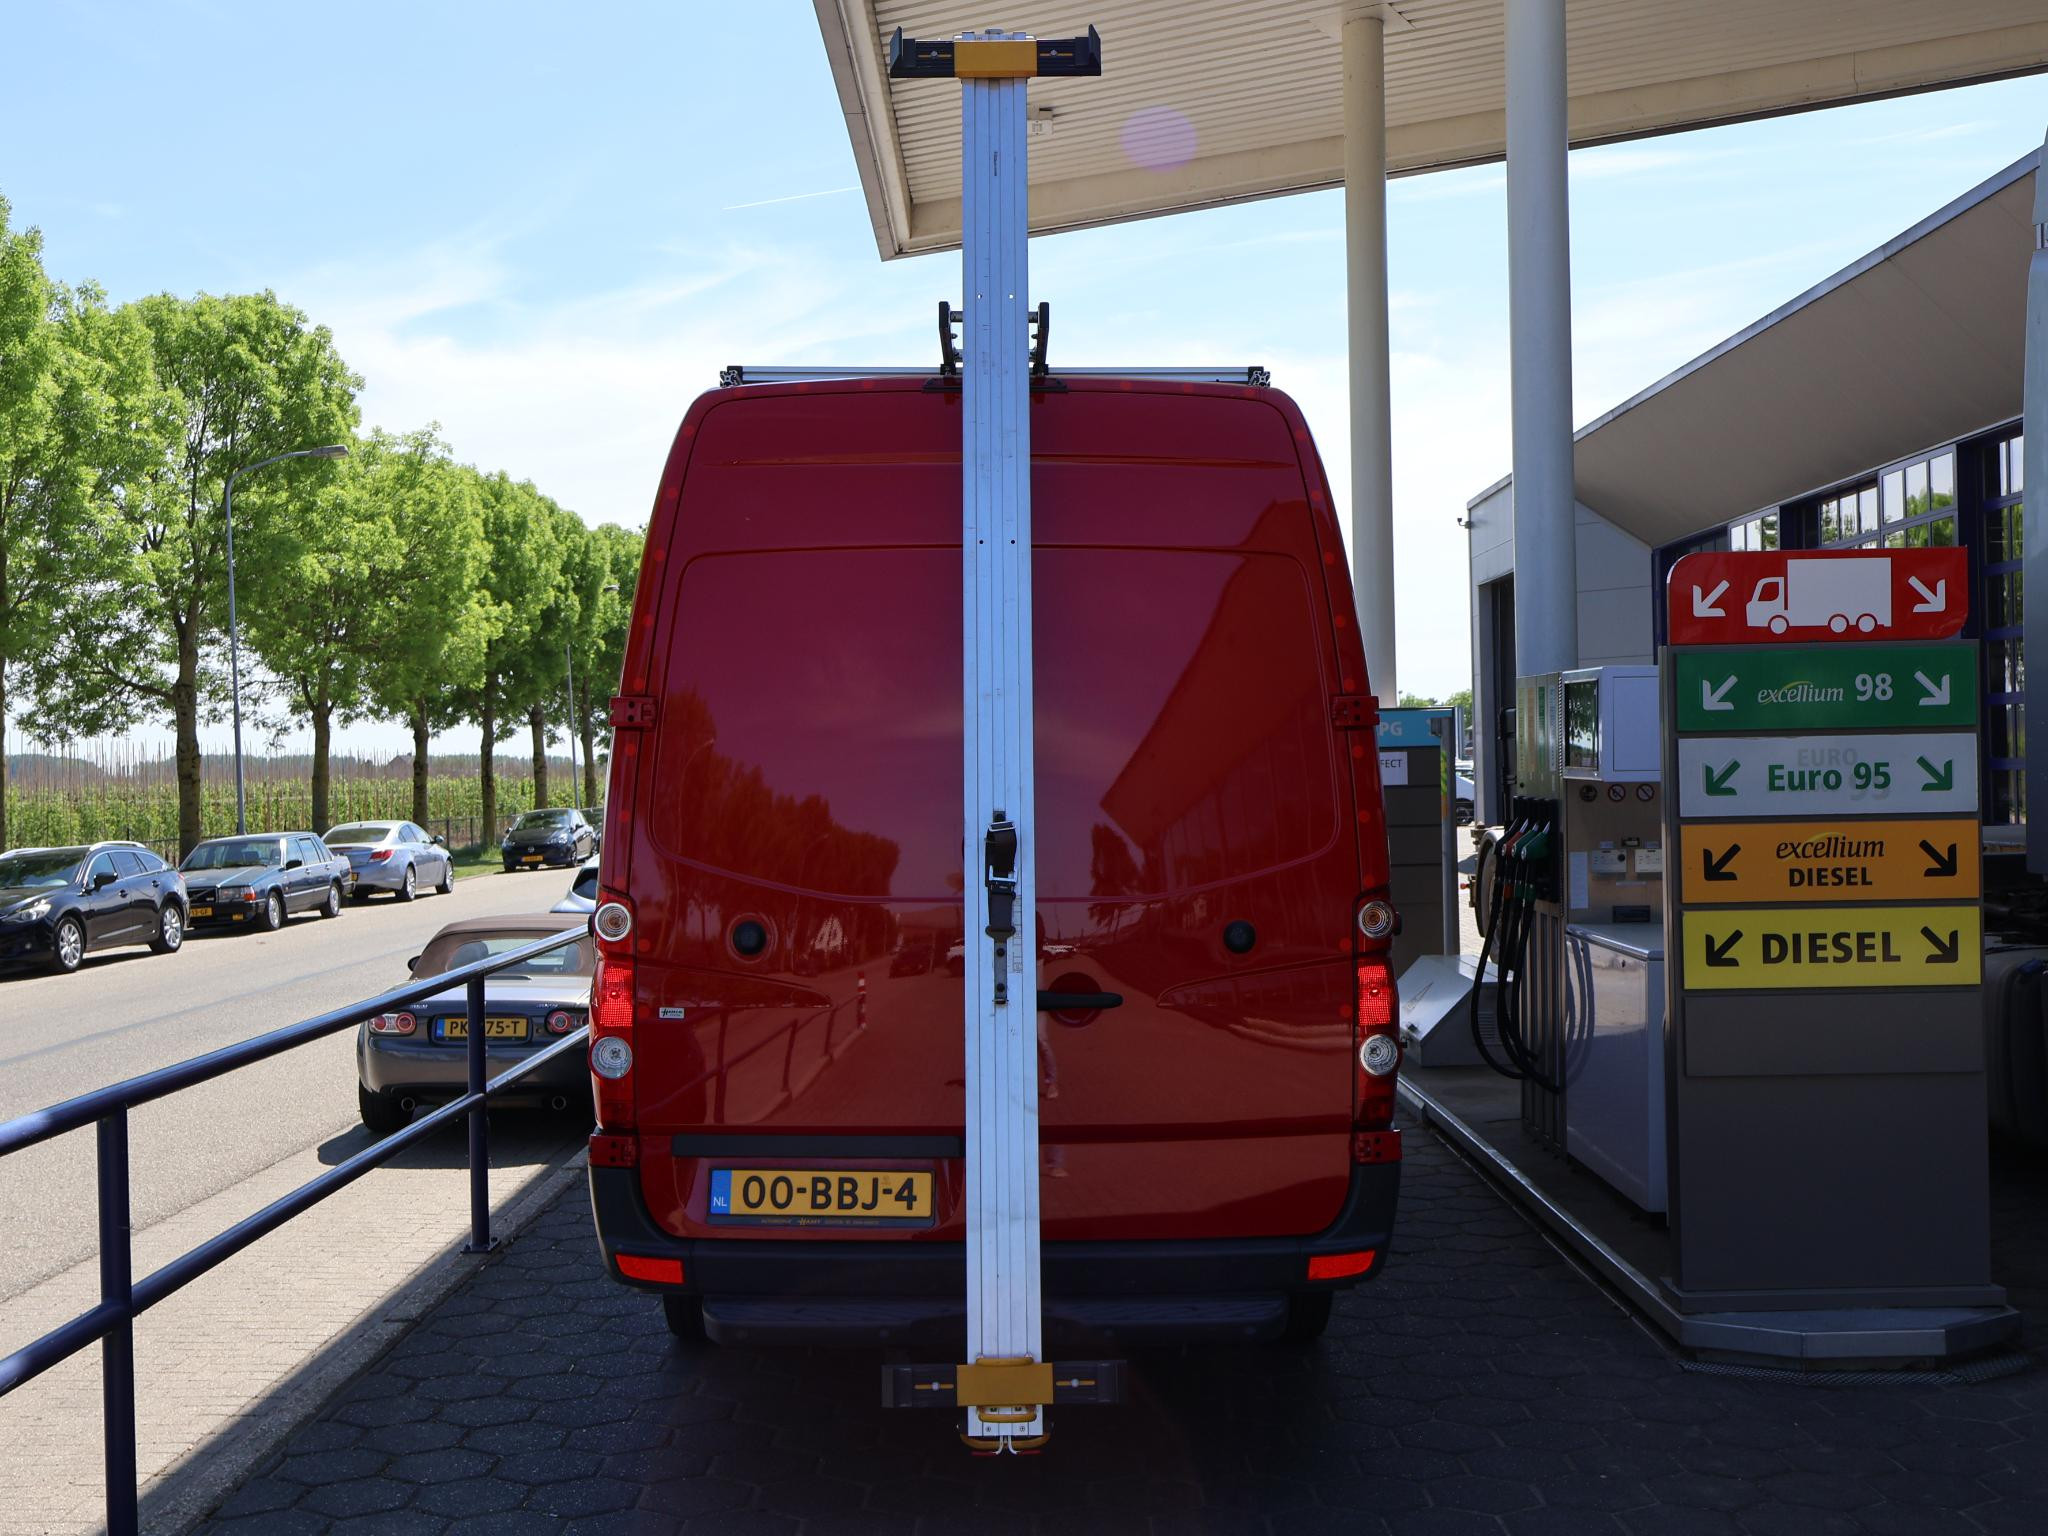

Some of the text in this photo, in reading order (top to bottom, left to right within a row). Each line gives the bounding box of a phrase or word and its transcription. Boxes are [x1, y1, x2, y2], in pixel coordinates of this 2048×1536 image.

[1757, 672, 1894, 705] excellium 98
[1768, 764, 1843, 792] Euro
[1853, 761, 1891, 791] 95
[1776, 836, 1885, 860] excellium
[1788, 867, 1873, 887] DIESEL
[1761, 932, 1902, 965] DIESEL
[713, 1174, 918, 1211] NL 00-BBJ-4
